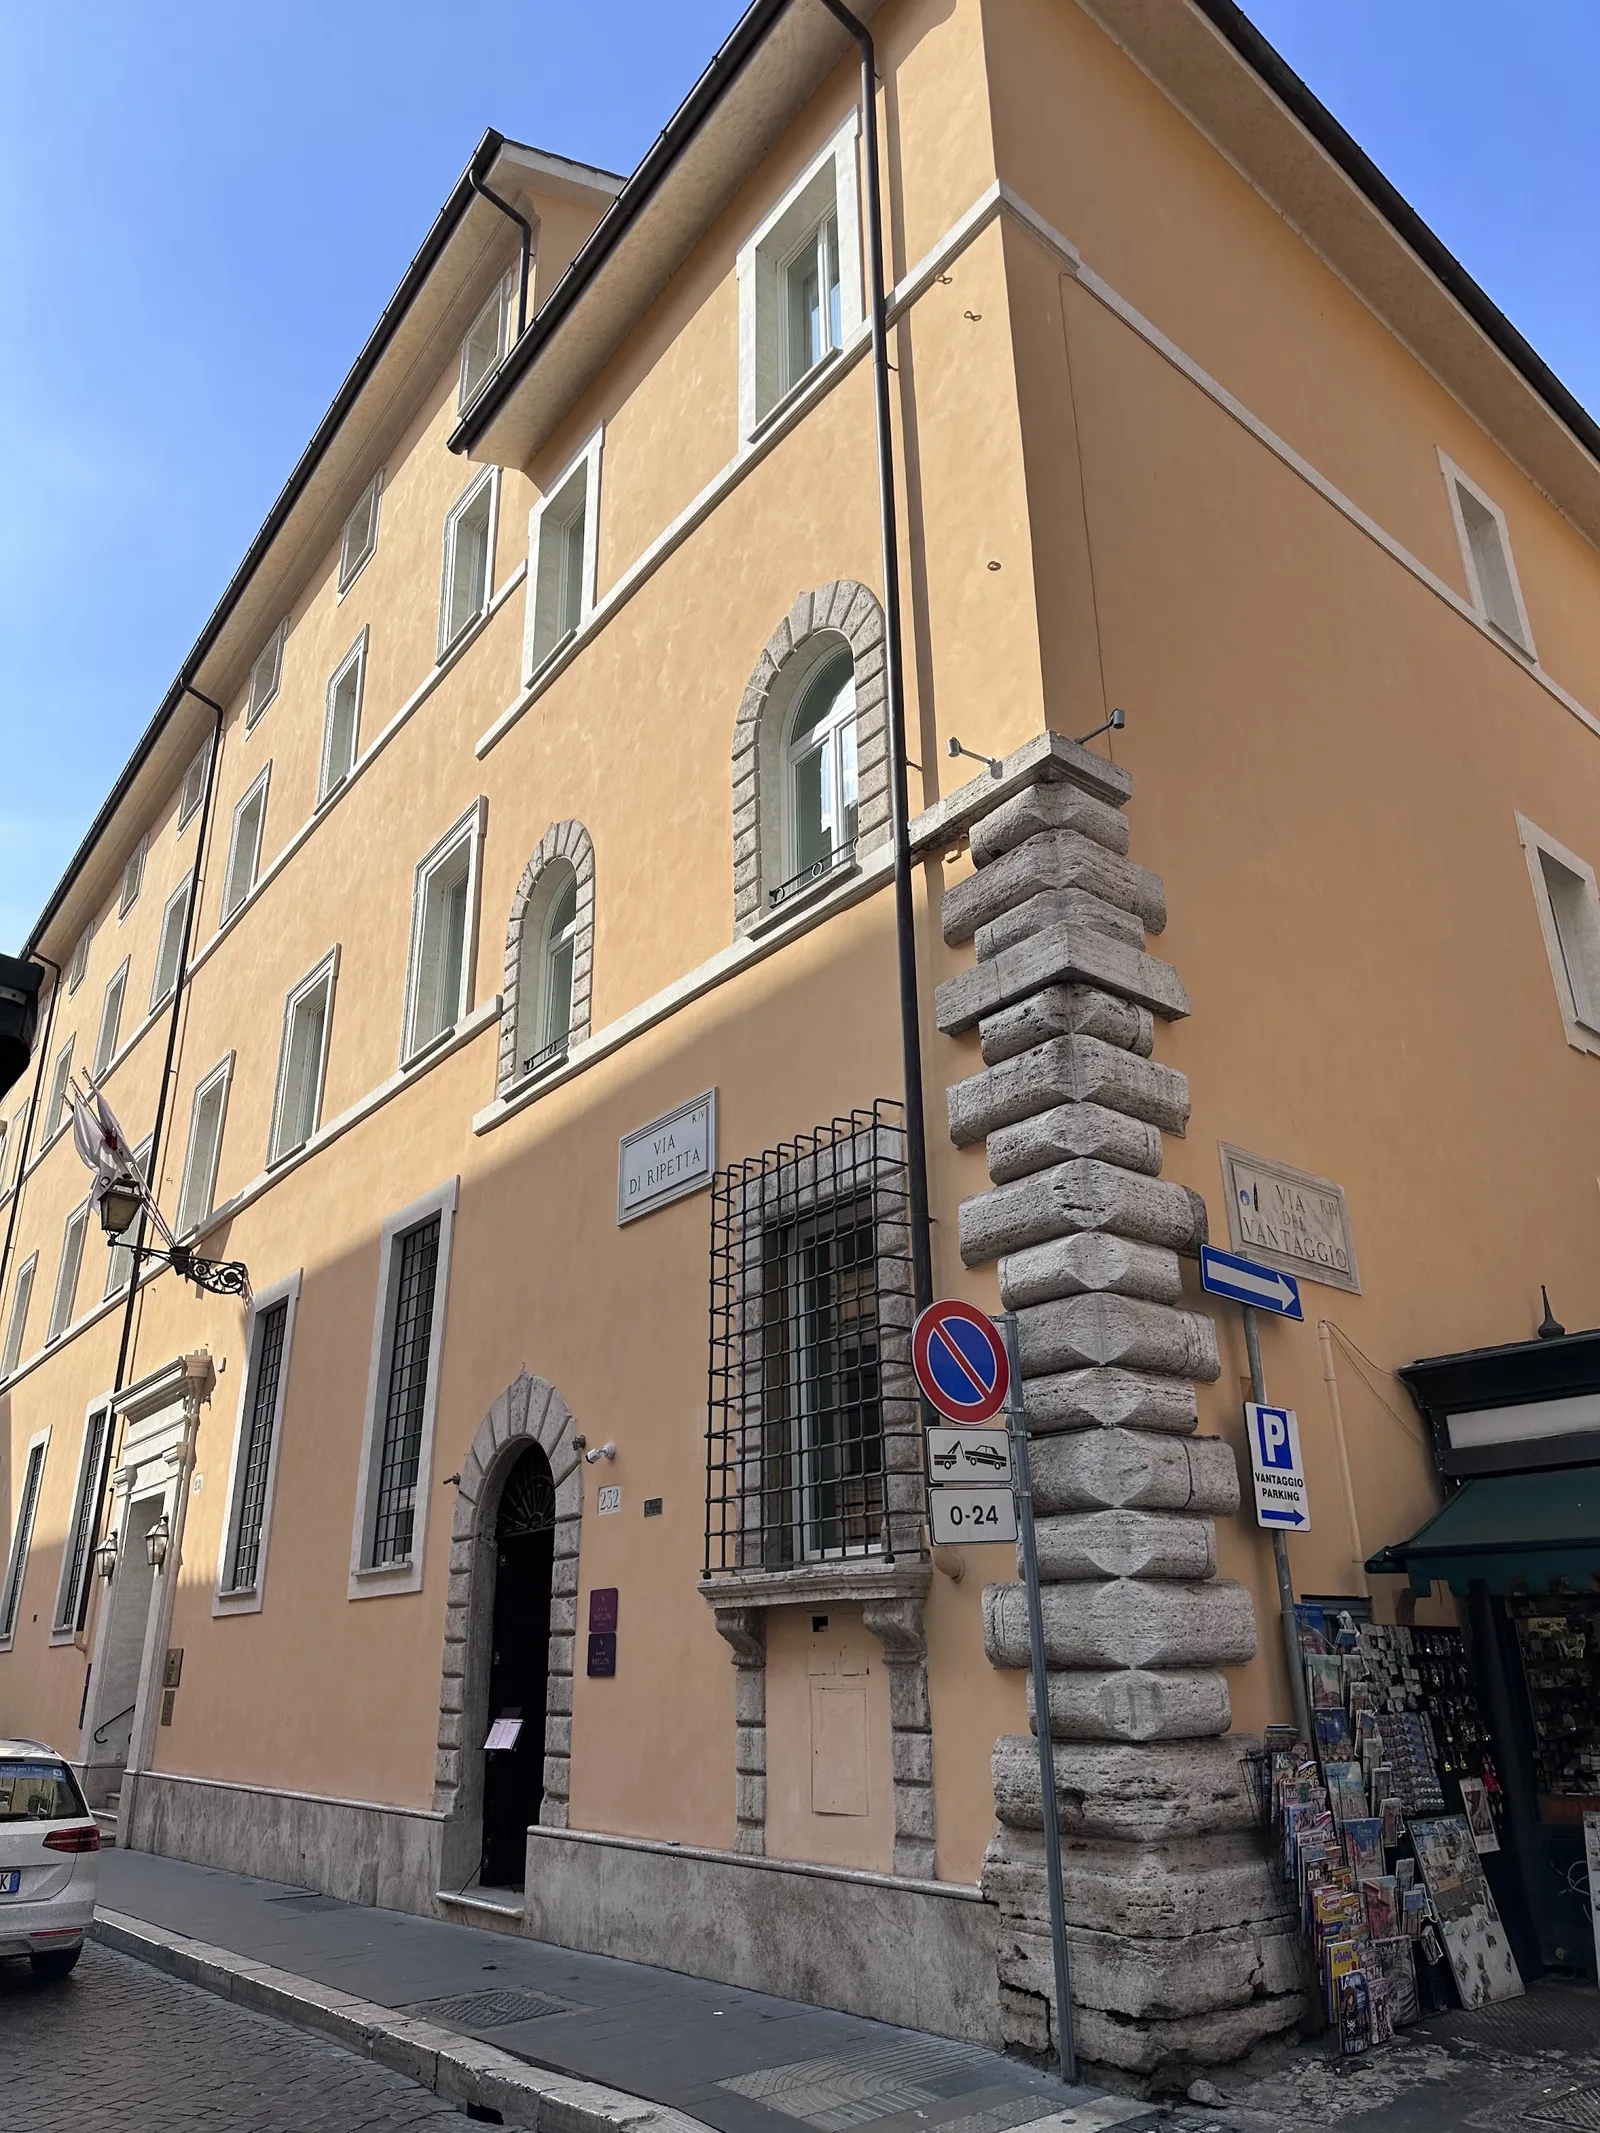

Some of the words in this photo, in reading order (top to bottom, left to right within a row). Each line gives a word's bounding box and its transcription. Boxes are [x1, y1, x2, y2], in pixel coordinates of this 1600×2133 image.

[653, 1134, 676, 1156] VIA
[629, 1175, 641, 1195] DI
[647, 1148, 700, 1186] RIPETTA
[1276, 1185, 1305, 1213] VIA
[1281, 1211, 1306, 1232] DEL
[1242, 1217, 1347, 1268] VANTAGGIO
[1263, 1413, 1285, 1462] P
[1255, 1472, 1303, 1488] VANTAGGIO
[600, 1489, 619, 1511] 232
[1261, 1487, 1300, 1501] PARKING
[950, 1505, 999, 1526] 0-24
